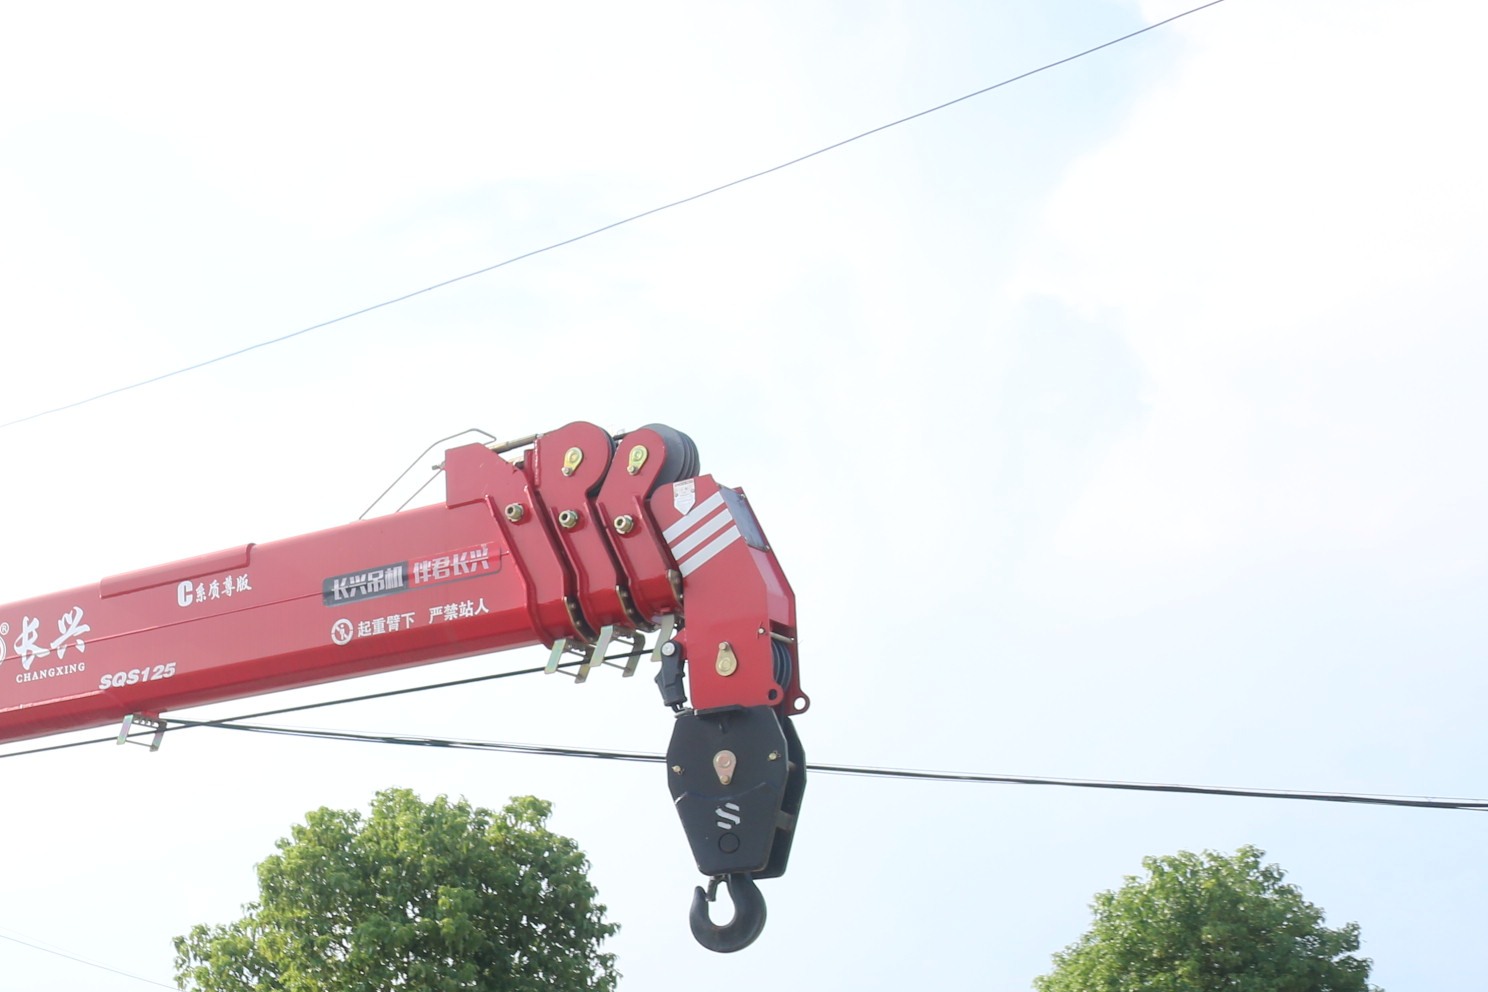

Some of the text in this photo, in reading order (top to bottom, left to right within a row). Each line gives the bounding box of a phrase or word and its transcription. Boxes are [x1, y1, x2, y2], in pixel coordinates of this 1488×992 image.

[330, 548, 489, 601] 长兴吊机 伴君长兴
[357, 598, 489, 638] 起重臂下 严禁站人
[13, 606, 91, 671] 长兴
[15, 661, 86, 684] CHANGXING
[98, 661, 177, 690] SQS125
